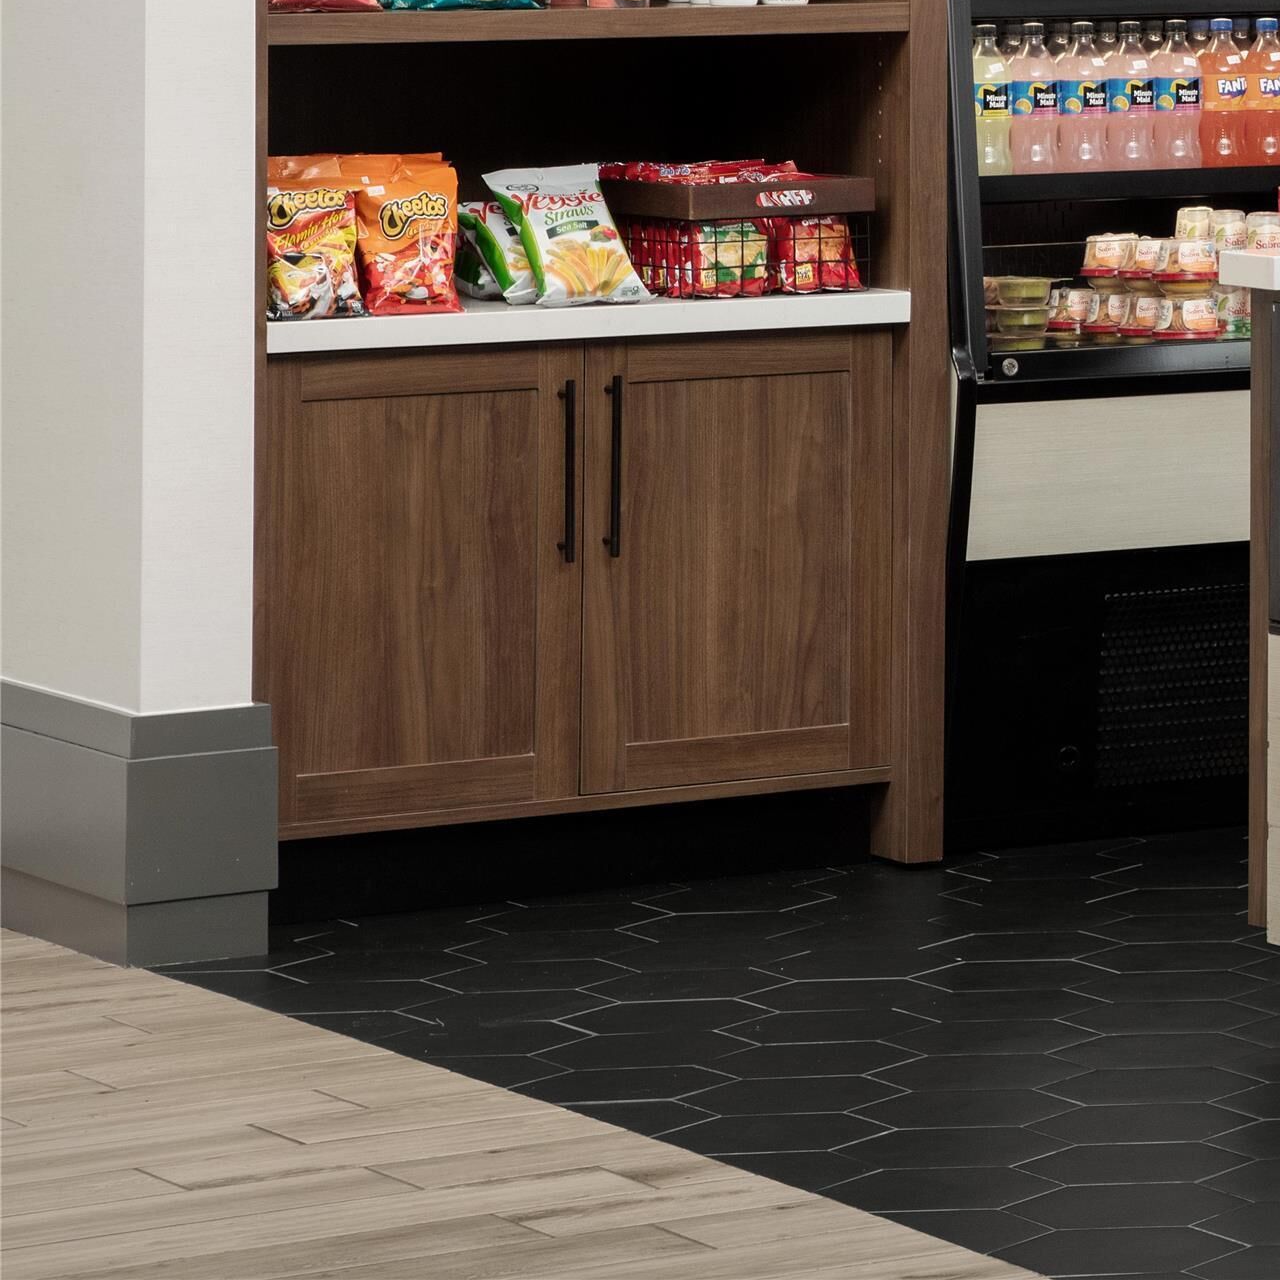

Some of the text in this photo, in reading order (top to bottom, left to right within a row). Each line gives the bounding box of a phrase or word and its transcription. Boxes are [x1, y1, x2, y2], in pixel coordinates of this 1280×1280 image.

[1036, 92, 1057, 100] Minute
[1086, 92, 1106, 100] Minute
[1133, 89, 1152, 98] Minute
[1179, 89, 1201, 97] Minute
[989, 101, 1005, 109] Maid
[1039, 99, 1055, 107] Maid
[1089, 98, 1104, 106] Maid
[511, 192, 604, 216] Veggie
[269, 189, 347, 228] Cheetos
[380, 192, 448, 238] Cheetos
[544, 204, 594, 225] Straws
[556, 222, 587, 233] Sea Salt
